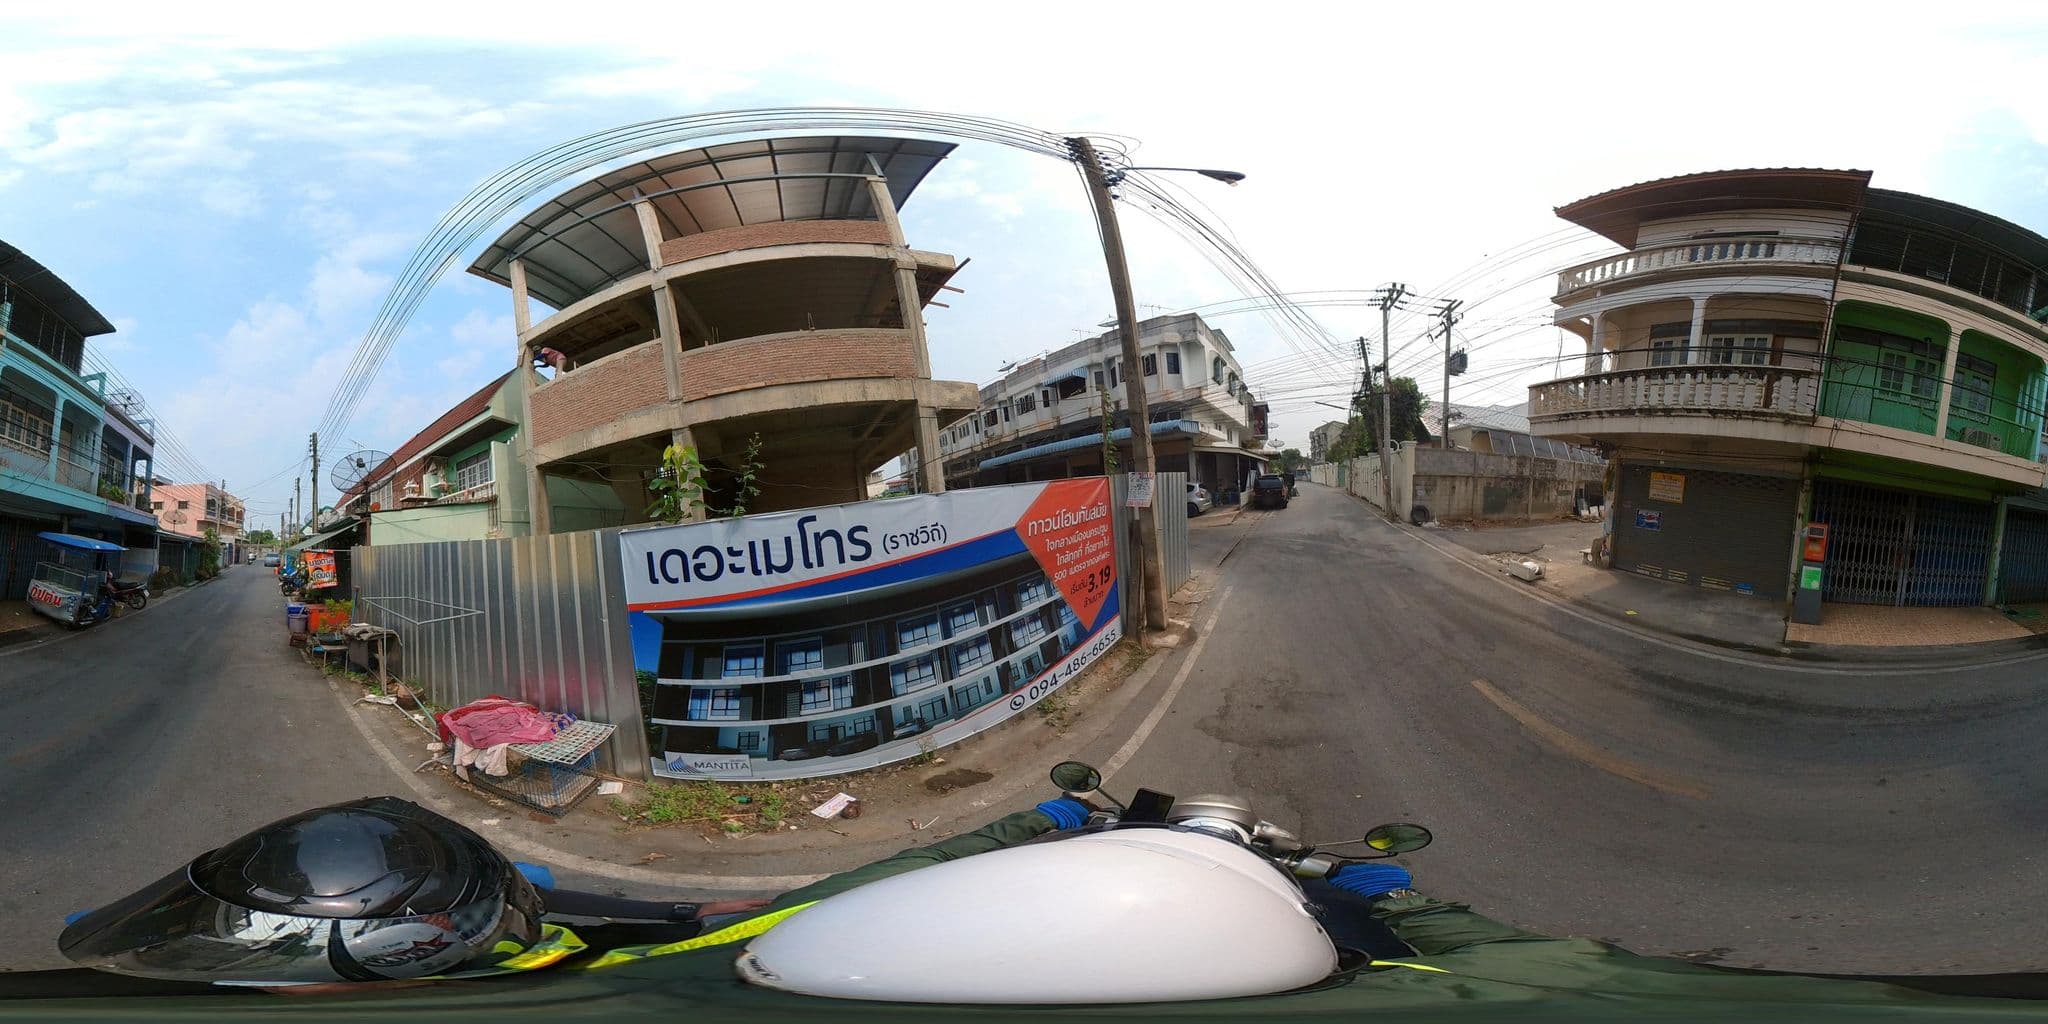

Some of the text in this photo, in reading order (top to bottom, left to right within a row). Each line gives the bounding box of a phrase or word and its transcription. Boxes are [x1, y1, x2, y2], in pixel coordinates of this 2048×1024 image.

[1028, 502, 1107, 537] ทาวน์โฮมทันสมัย
[646, 515, 948, 585] เดอะเมโทร (ราชวิถี)
[1088, 565, 1111, 593] 3.19
[1029, 629, 1117, 700] 094-486-6655
[694, 761, 749, 770] MANTITA
